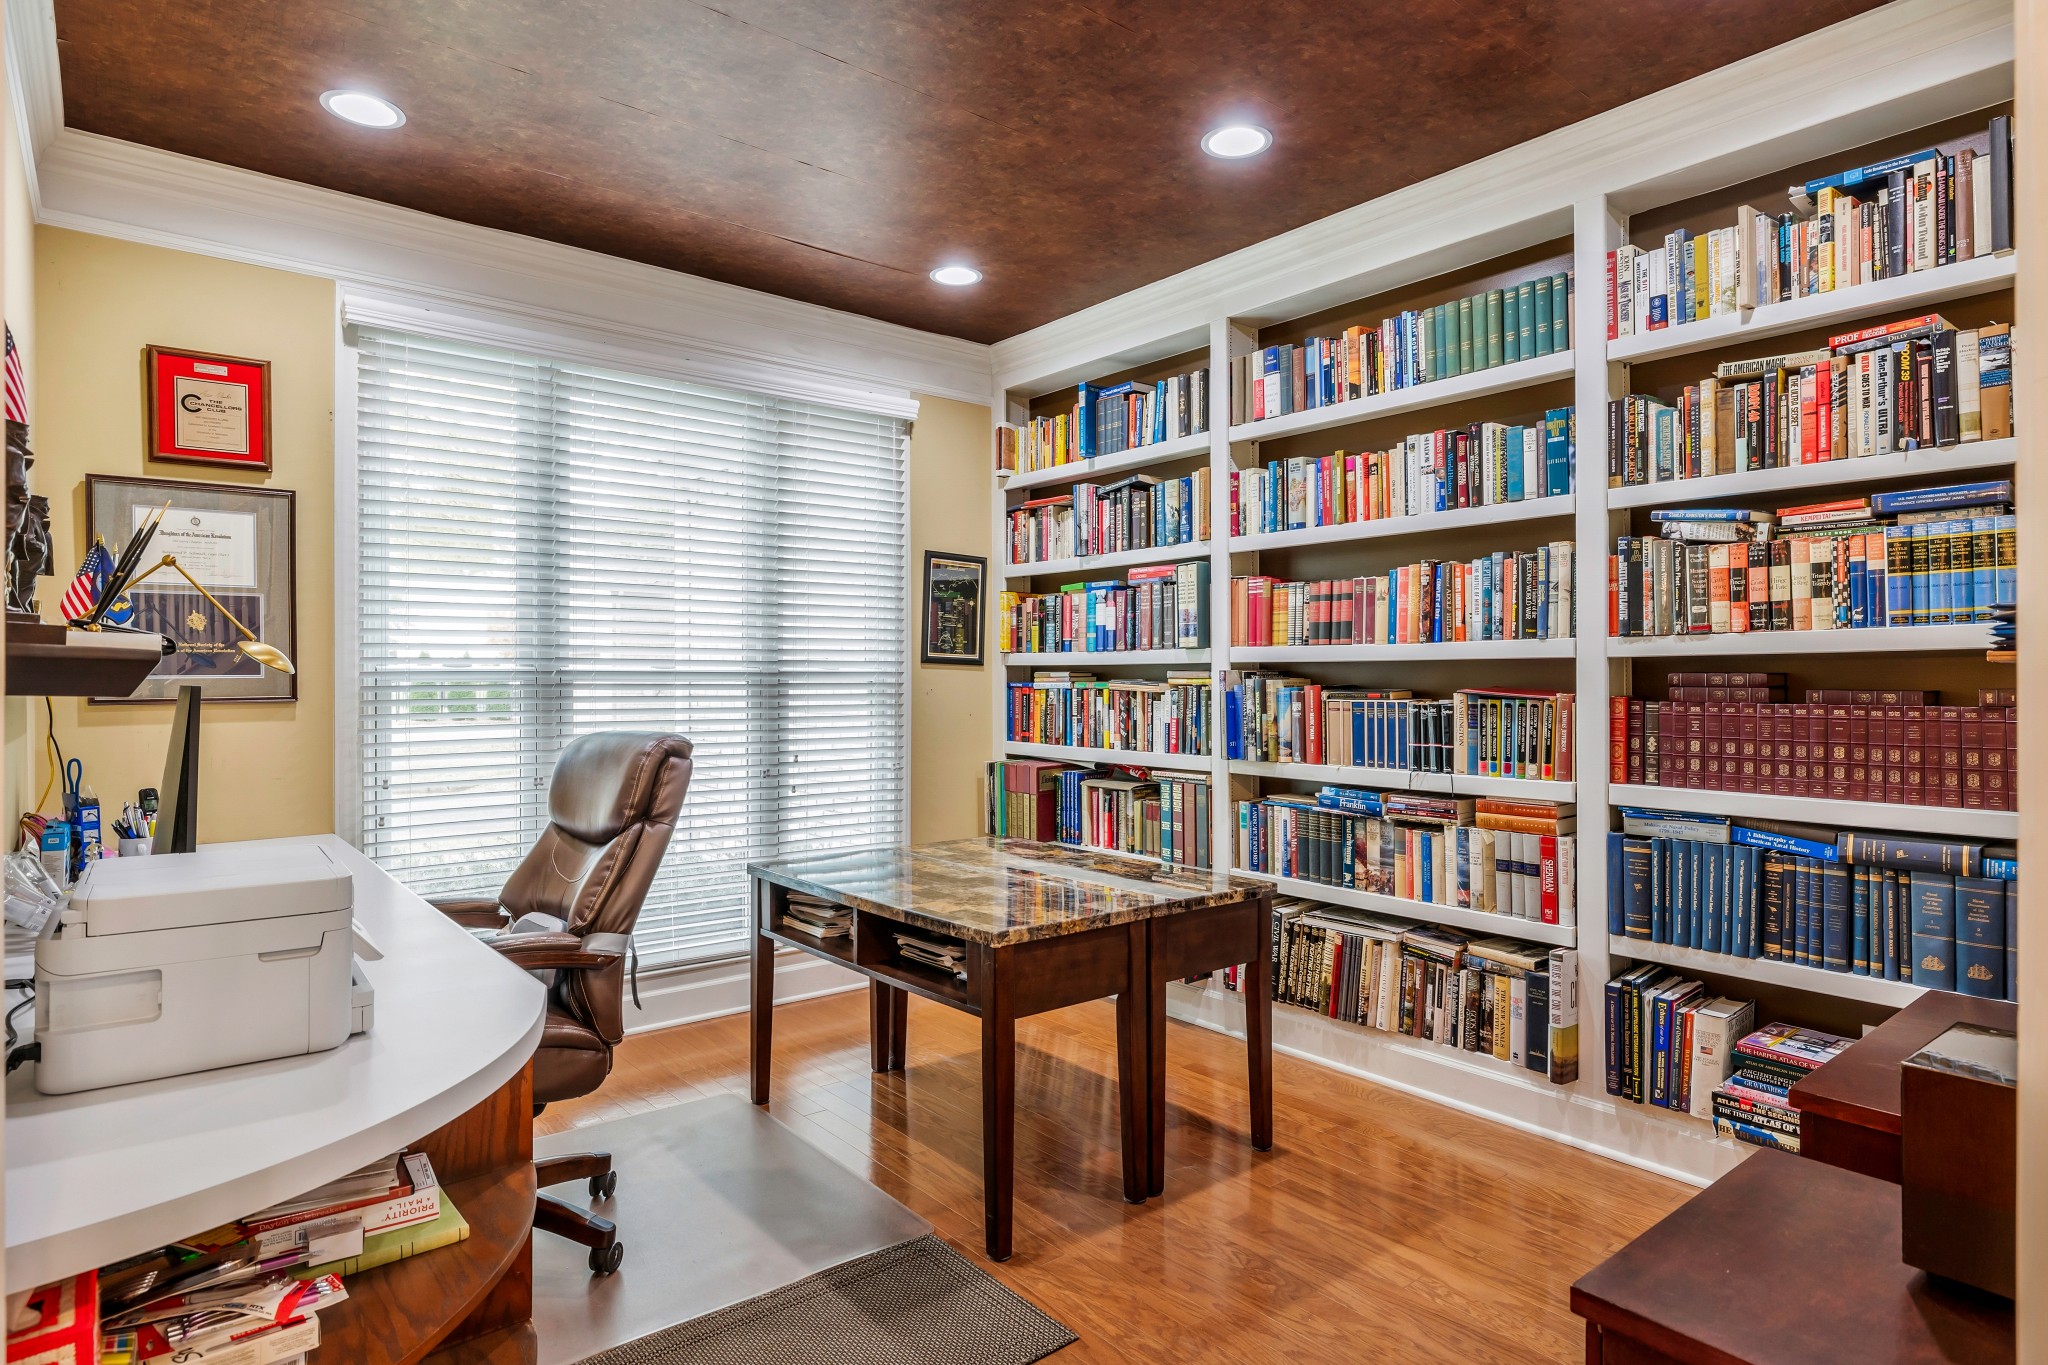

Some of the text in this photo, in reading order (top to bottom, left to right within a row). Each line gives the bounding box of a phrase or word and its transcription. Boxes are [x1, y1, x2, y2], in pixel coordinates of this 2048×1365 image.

[1914, 173, 1932, 260] Infamy John Toland
[1936, 176, 1946, 256] HAWAII UNDER THE RISING SUN
[1668, 236, 1676, 256] STEPHEN
[1668, 262, 1676, 286] AMBROSE
[1835, 332, 1859, 345] PROF
[1888, 332, 1907, 342] DILLY
[1722, 356, 1786, 377] THE AMERICAN MAGIC
[1862, 355, 1870, 373] ULTRA
[1862, 374, 1870, 388] GOES
[1748, 383, 1760, 422] ROOM 40
[1790, 377, 1799, 427] THE ULTRA SECRET
[1862, 388, 1870, 396] TO
[1862, 396, 1870, 409] WAR
[1878, 354, 1888, 436] MacArthur's ULTRA
[189, 401, 242, 411] CHANCELLORS
[1831, 373, 1840, 442] SEIZING THE ENIGMA
[1628, 405, 1636, 432] WORLD
[1701, 411, 1712, 438] CODE
[1423, 435, 1431, 463] SHADOW
[1628, 434, 1636, 445] OF
[1628, 447, 1636, 481] SECRETS
[158, 529, 180, 537] Daughters
[1483, 560, 1491, 589] NEPTUNE
[1619, 591, 1627, 620] ATLANTIC
[1560, 710, 1568, 753] THOMAS JEFFERSON
[1339, 799, 1366, 811] Franklin
[1644, 821, 1661, 829] Makers
[1746, 837, 1810, 854] American Naval History
[1753, 832, 1787, 844] Bibliography
[1545, 858, 1555, 893] SHERMAN
[1272, 921, 1280, 962] CIVIL WAR
[1551, 963, 1562, 978] ATLAS
[1494, 987, 1500, 996] OF
[1551, 989, 1562, 997] THE
[1551, 999, 1562, 1011] CIVIL
[1657, 1002, 1667, 1025] Echoes
[1469, 1010, 1477, 1045] GODS AND
[1551, 1013, 1562, 1025] WAR
[1740, 1047, 1753, 1055] THE
[1753, 1050, 1778, 1061] HARPER
[1778, 1055, 1799, 1066] ATLAS
[1798, 1061, 1809, 1069] OF
[1742, 1072, 1782, 1086] CHRISTOPHER
[1717, 1097, 1800, 1125] ATLAS OF THE SECOND
[1718, 1107, 1796, 1134] THE TIMES ATLAS OF
[384, 1201, 435, 1222] PRIORITY
[396, 1197, 423, 1209] MAIL
[259, 1218, 290, 1232] Dayton
[291, 1204, 348, 1224] Codebreakers
